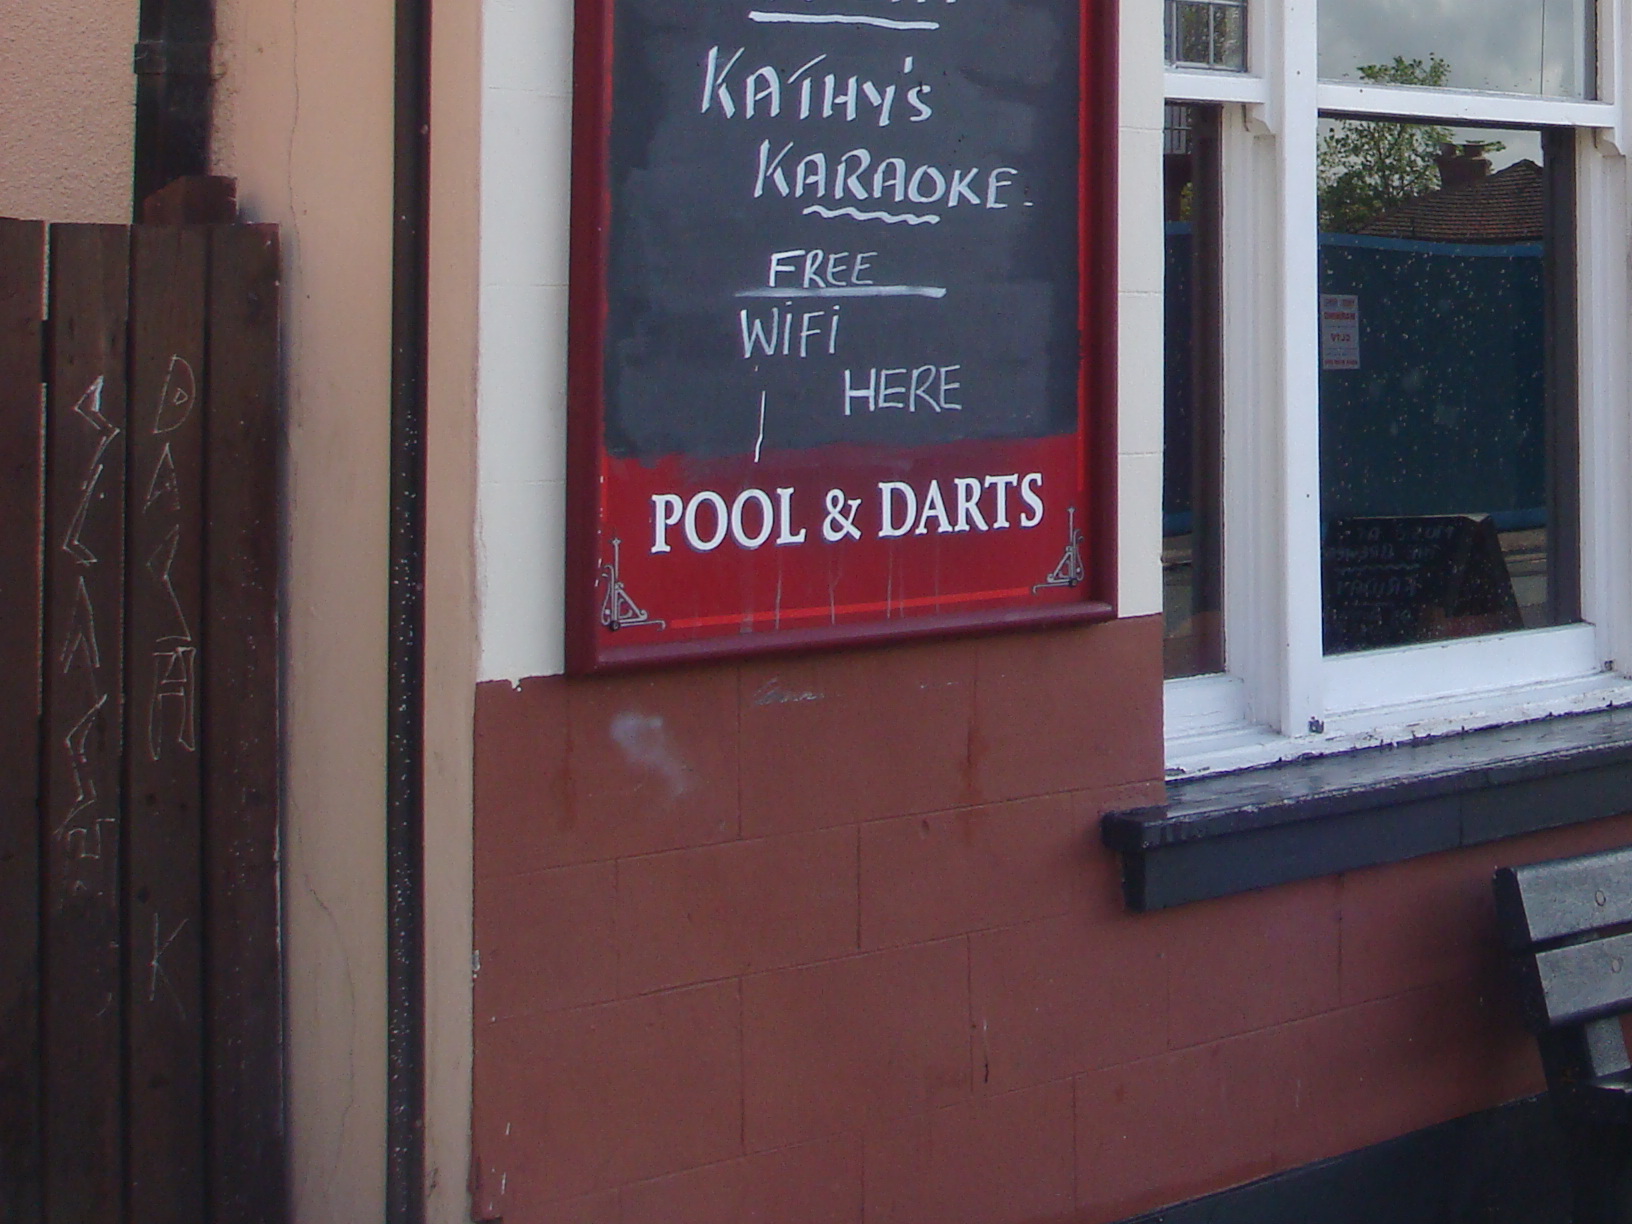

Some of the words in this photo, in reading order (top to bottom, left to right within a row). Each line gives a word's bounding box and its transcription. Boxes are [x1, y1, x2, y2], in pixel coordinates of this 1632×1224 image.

[768, 249, 878, 289] FREE
[844, 364, 962, 416] HERE
[650, 487, 806, 554] POOL
[822, 489, 861, 543] &
[877, 473, 1044, 539] DARTS
